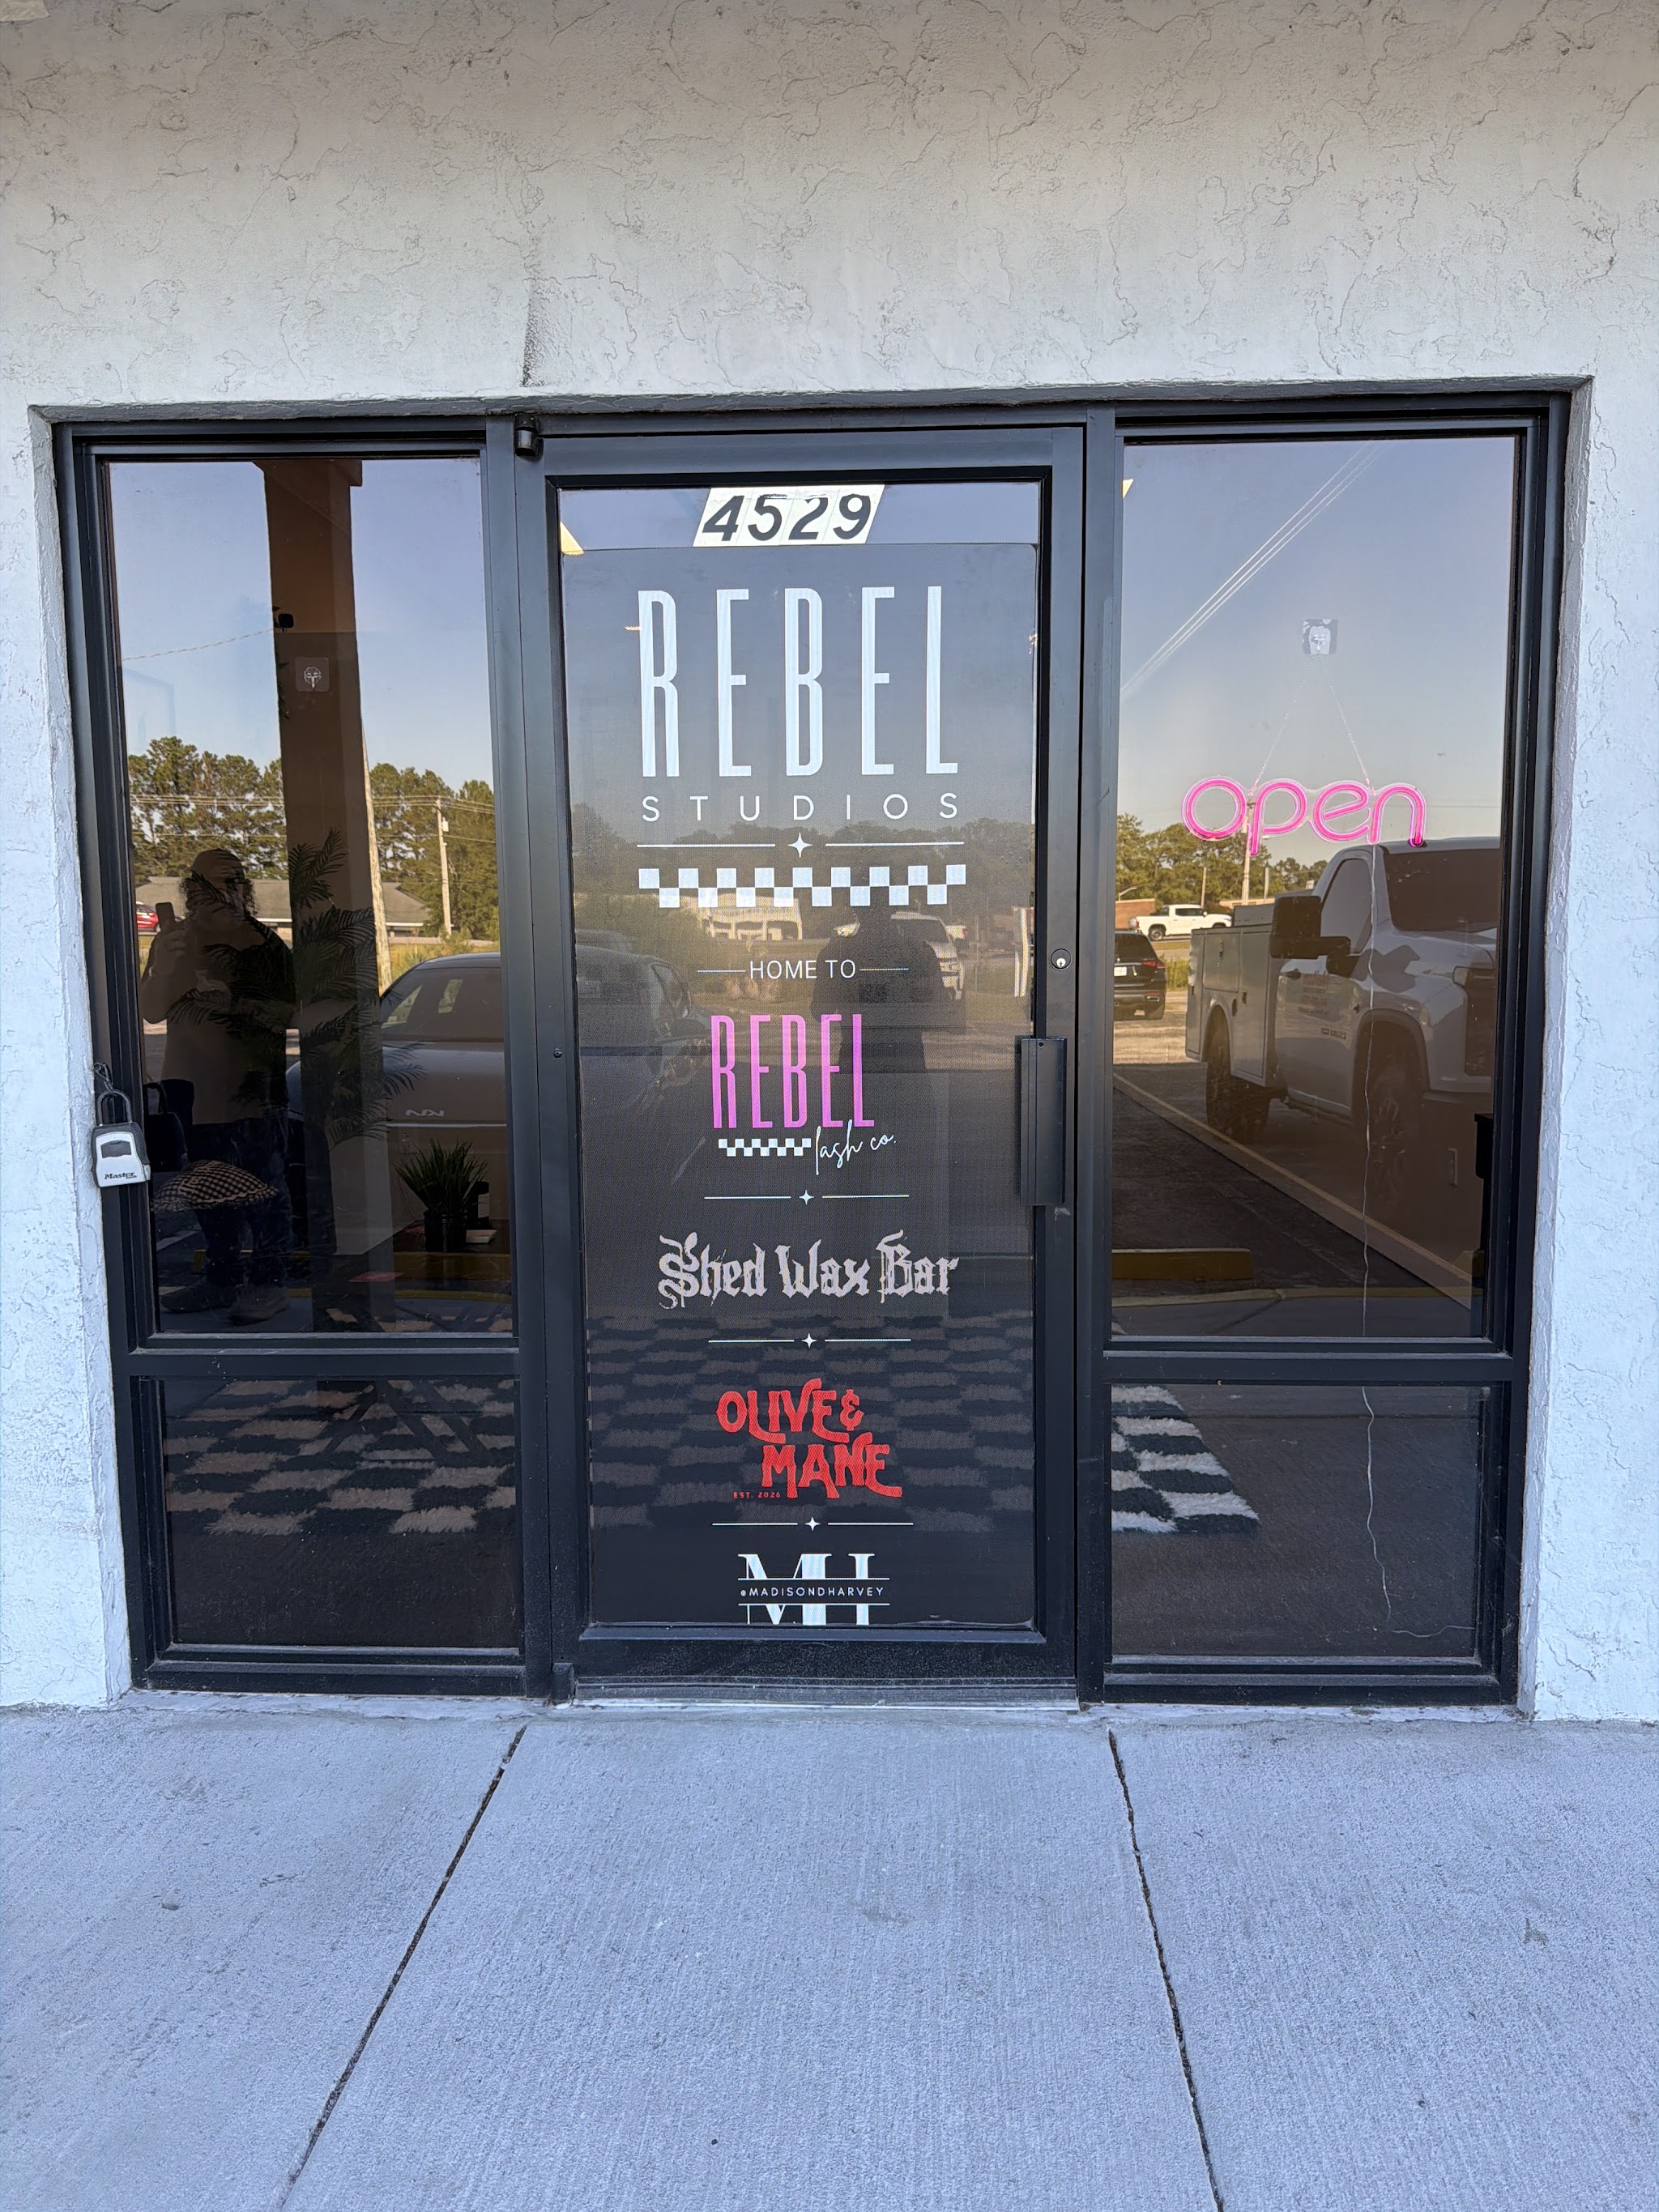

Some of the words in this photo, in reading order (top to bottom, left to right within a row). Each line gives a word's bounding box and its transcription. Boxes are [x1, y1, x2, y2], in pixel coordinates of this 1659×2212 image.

[702, 493, 871, 541] 4529
[638, 586, 958, 777] REBEL
[642, 793, 957, 821] STUDIOS
[1183, 778, 1426, 855] open
[749, 959, 817, 979] HOME
[825, 959, 856, 978] TO
[710, 1013, 875, 1129] REBEL
[816, 1119, 864, 1175] lash
[658, 1231, 768, 1309] Shed
[774, 1239, 872, 1298] Wax
[876, 1229, 959, 1304] Bar
[715, 1378, 850, 1445] OLIVE
[761, 1432, 903, 1499] MANE
[740, 1587, 884, 1597] @MADISONDHARVEY
